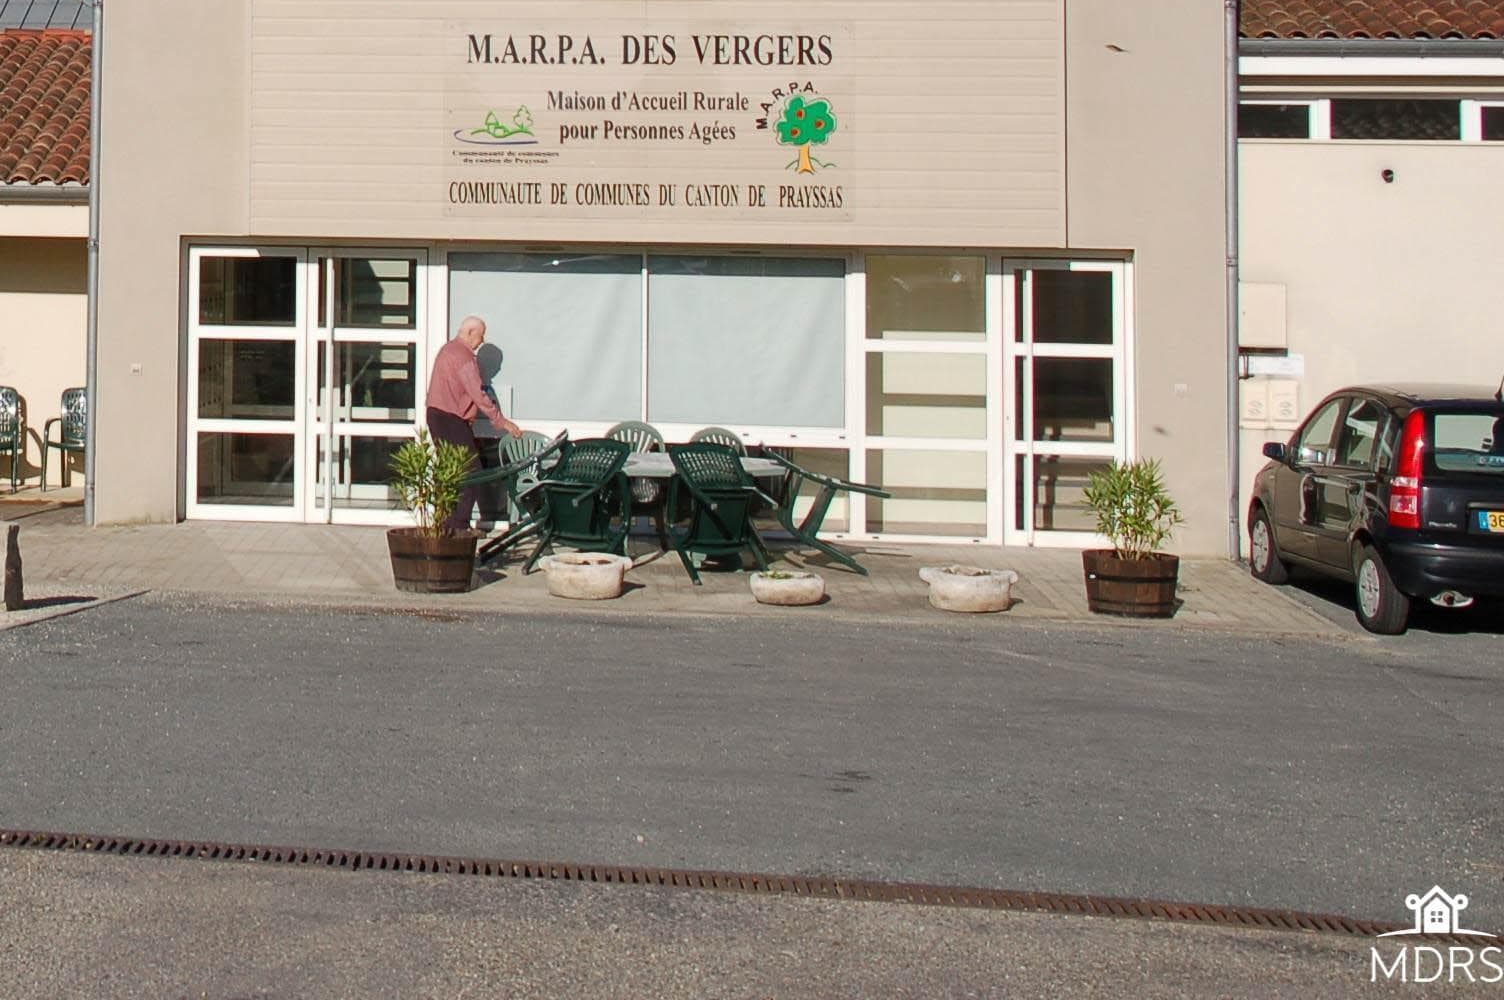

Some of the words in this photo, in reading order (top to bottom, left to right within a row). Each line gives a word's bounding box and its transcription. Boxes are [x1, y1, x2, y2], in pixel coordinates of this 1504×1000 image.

[467, 34, 606, 65] M.A.R.P.A.
[622, 34, 677, 65] DES
[691, 34, 833, 66] VERGERS
[547, 90, 606, 111] Maison
[693, 91, 750, 111] Rurale
[756, 81, 818, 130] M.A.R.P.A.
[559, 123, 598, 144] pour
[603, 120, 685, 140] Personnes
[688, 120, 736, 145] Agées
[449, 181, 542, 205] COMMUNAUTE
[551, 182, 568, 205] DE
[575, 182, 650, 206] COMMUNES
[659, 183, 677, 207] DU
[685, 184, 740, 207] CANTON
[748, 184, 766, 208] DE
[779, 185, 843, 209] PRAYSSAS
